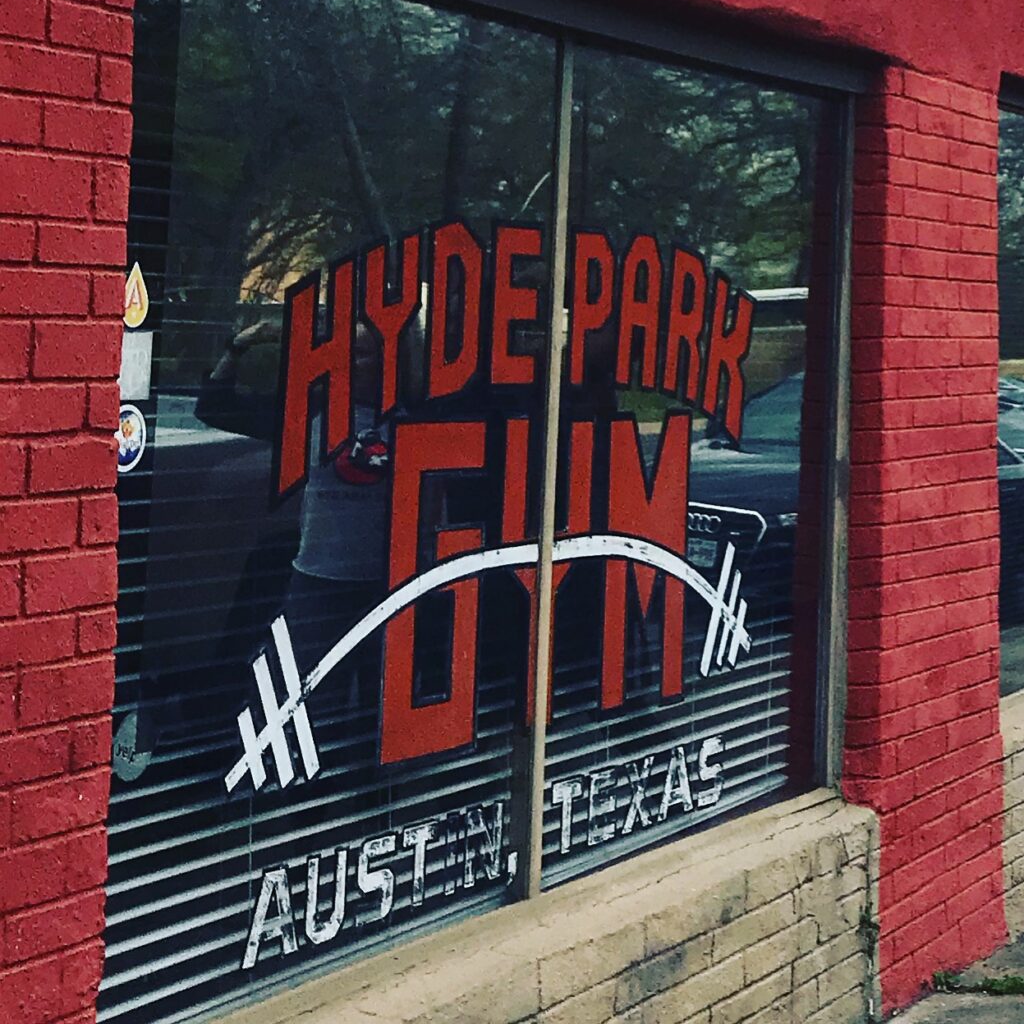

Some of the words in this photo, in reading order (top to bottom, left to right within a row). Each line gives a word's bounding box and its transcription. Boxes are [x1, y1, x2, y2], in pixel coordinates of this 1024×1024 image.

[279, 221, 542, 495] HYDE
[570, 231, 754, 443] PARK
[380, 407, 693, 766] GYM
[241, 801, 518, 970] AUSTIN,
[551, 736, 727, 855] TEXAS
